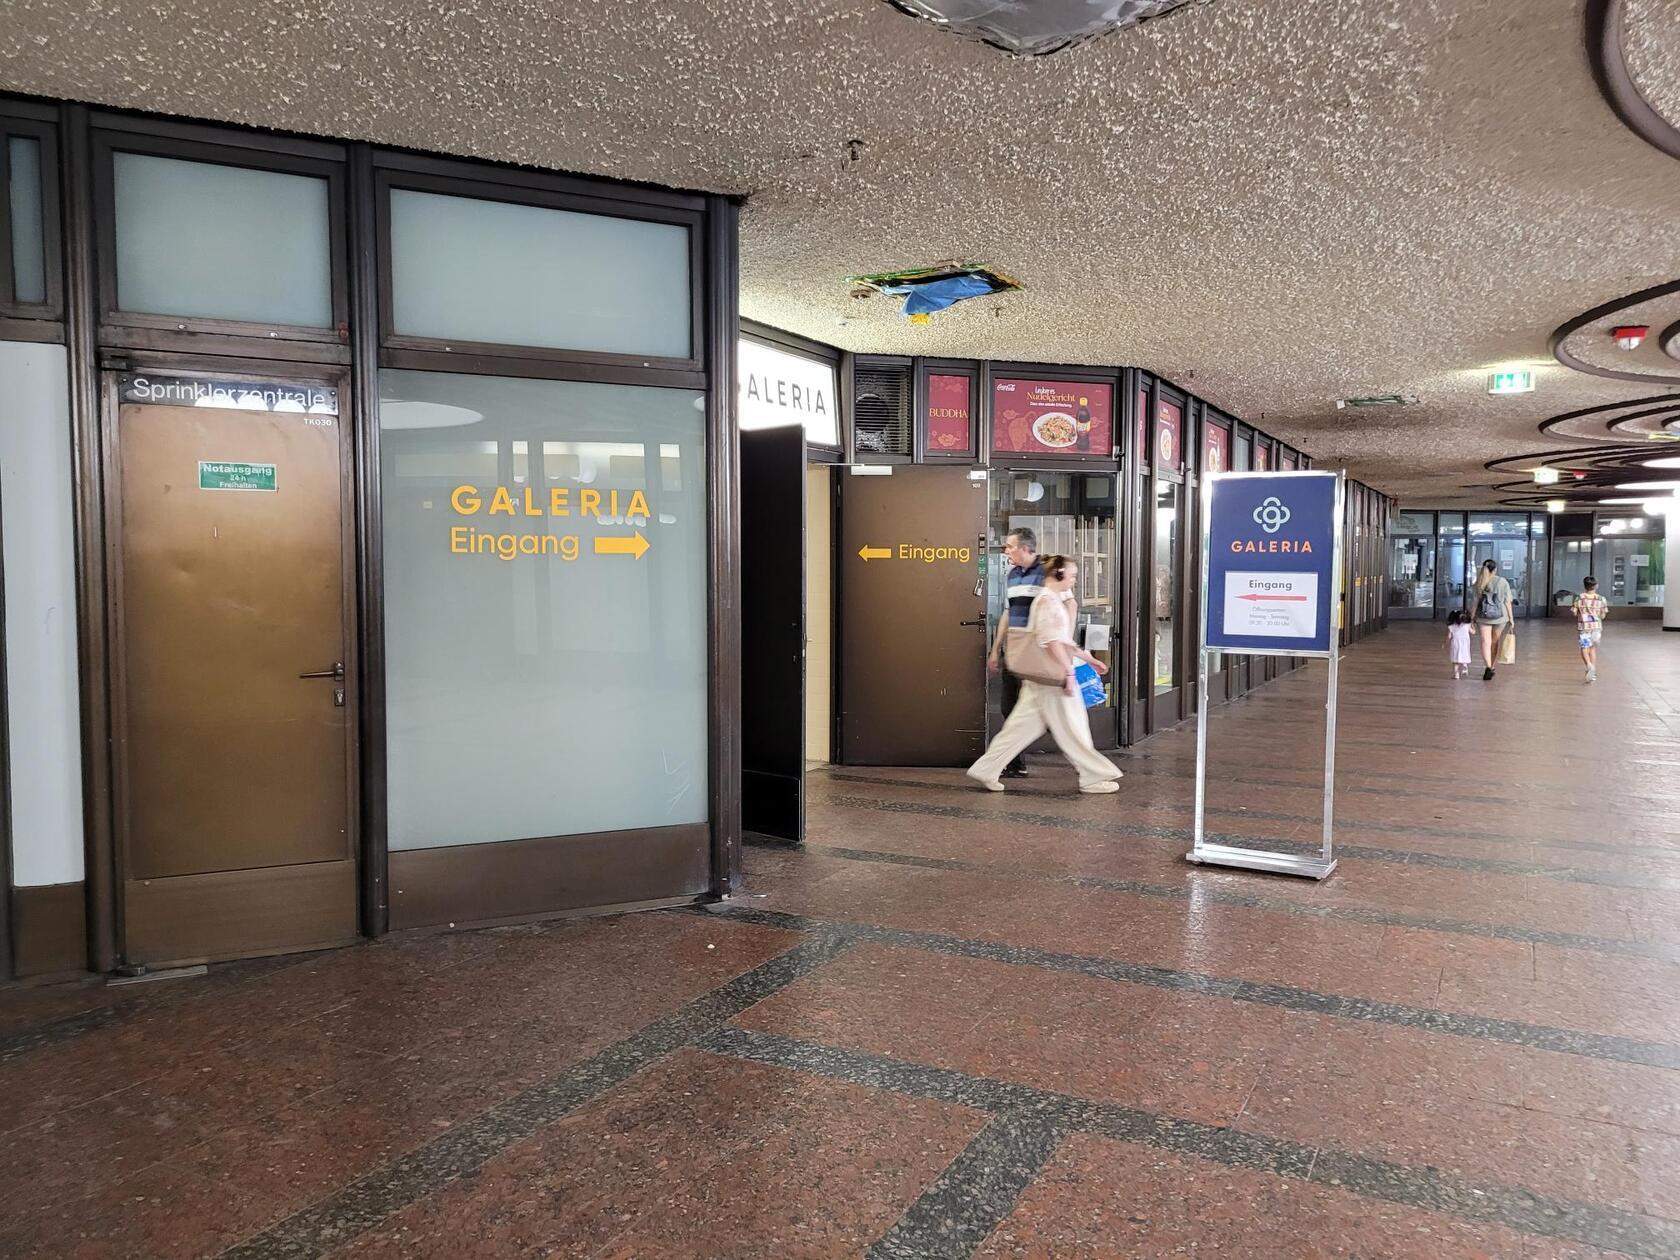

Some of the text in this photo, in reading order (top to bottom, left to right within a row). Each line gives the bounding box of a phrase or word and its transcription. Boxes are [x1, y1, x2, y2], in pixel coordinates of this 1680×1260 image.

[738, 373, 826, 415] ALERIA
[1027, 392, 1076, 402] Nudelgericht
[929, 407, 968, 418] BUDDHA
[203, 463, 272, 476] Notausgang
[220, 481, 257, 489] Freihalten
[451, 485, 650, 518] GALERIA
[451, 527, 579, 561] Eingang
[1231, 540, 1312, 553] GALERIA
[899, 544, 970, 563] Eingang
[1249, 580, 1292, 591] Eingang
